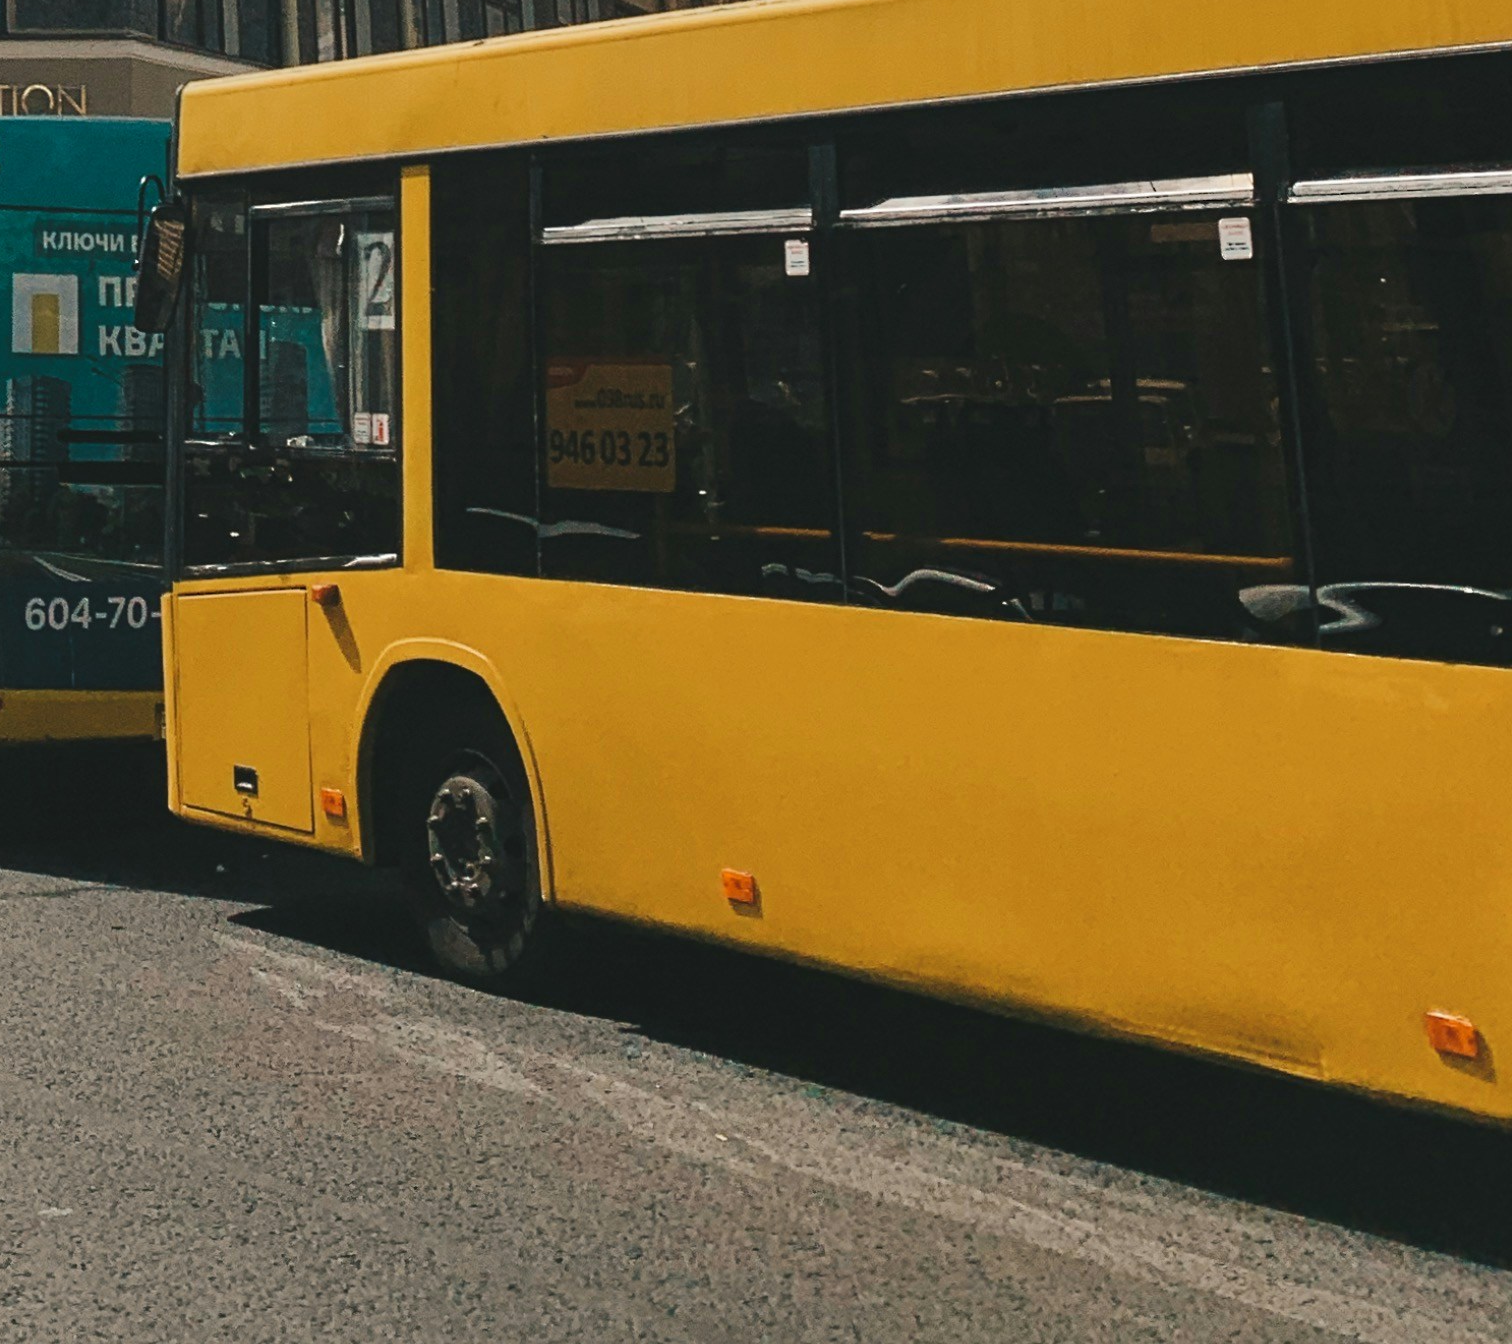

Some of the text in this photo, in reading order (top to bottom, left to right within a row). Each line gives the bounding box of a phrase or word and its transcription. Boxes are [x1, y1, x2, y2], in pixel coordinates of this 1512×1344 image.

[42, 230, 124, 253] КЛЮЧИ
[549, 429, 670, 467] 946 03 23
[24, 596, 161, 630] 604-70-
